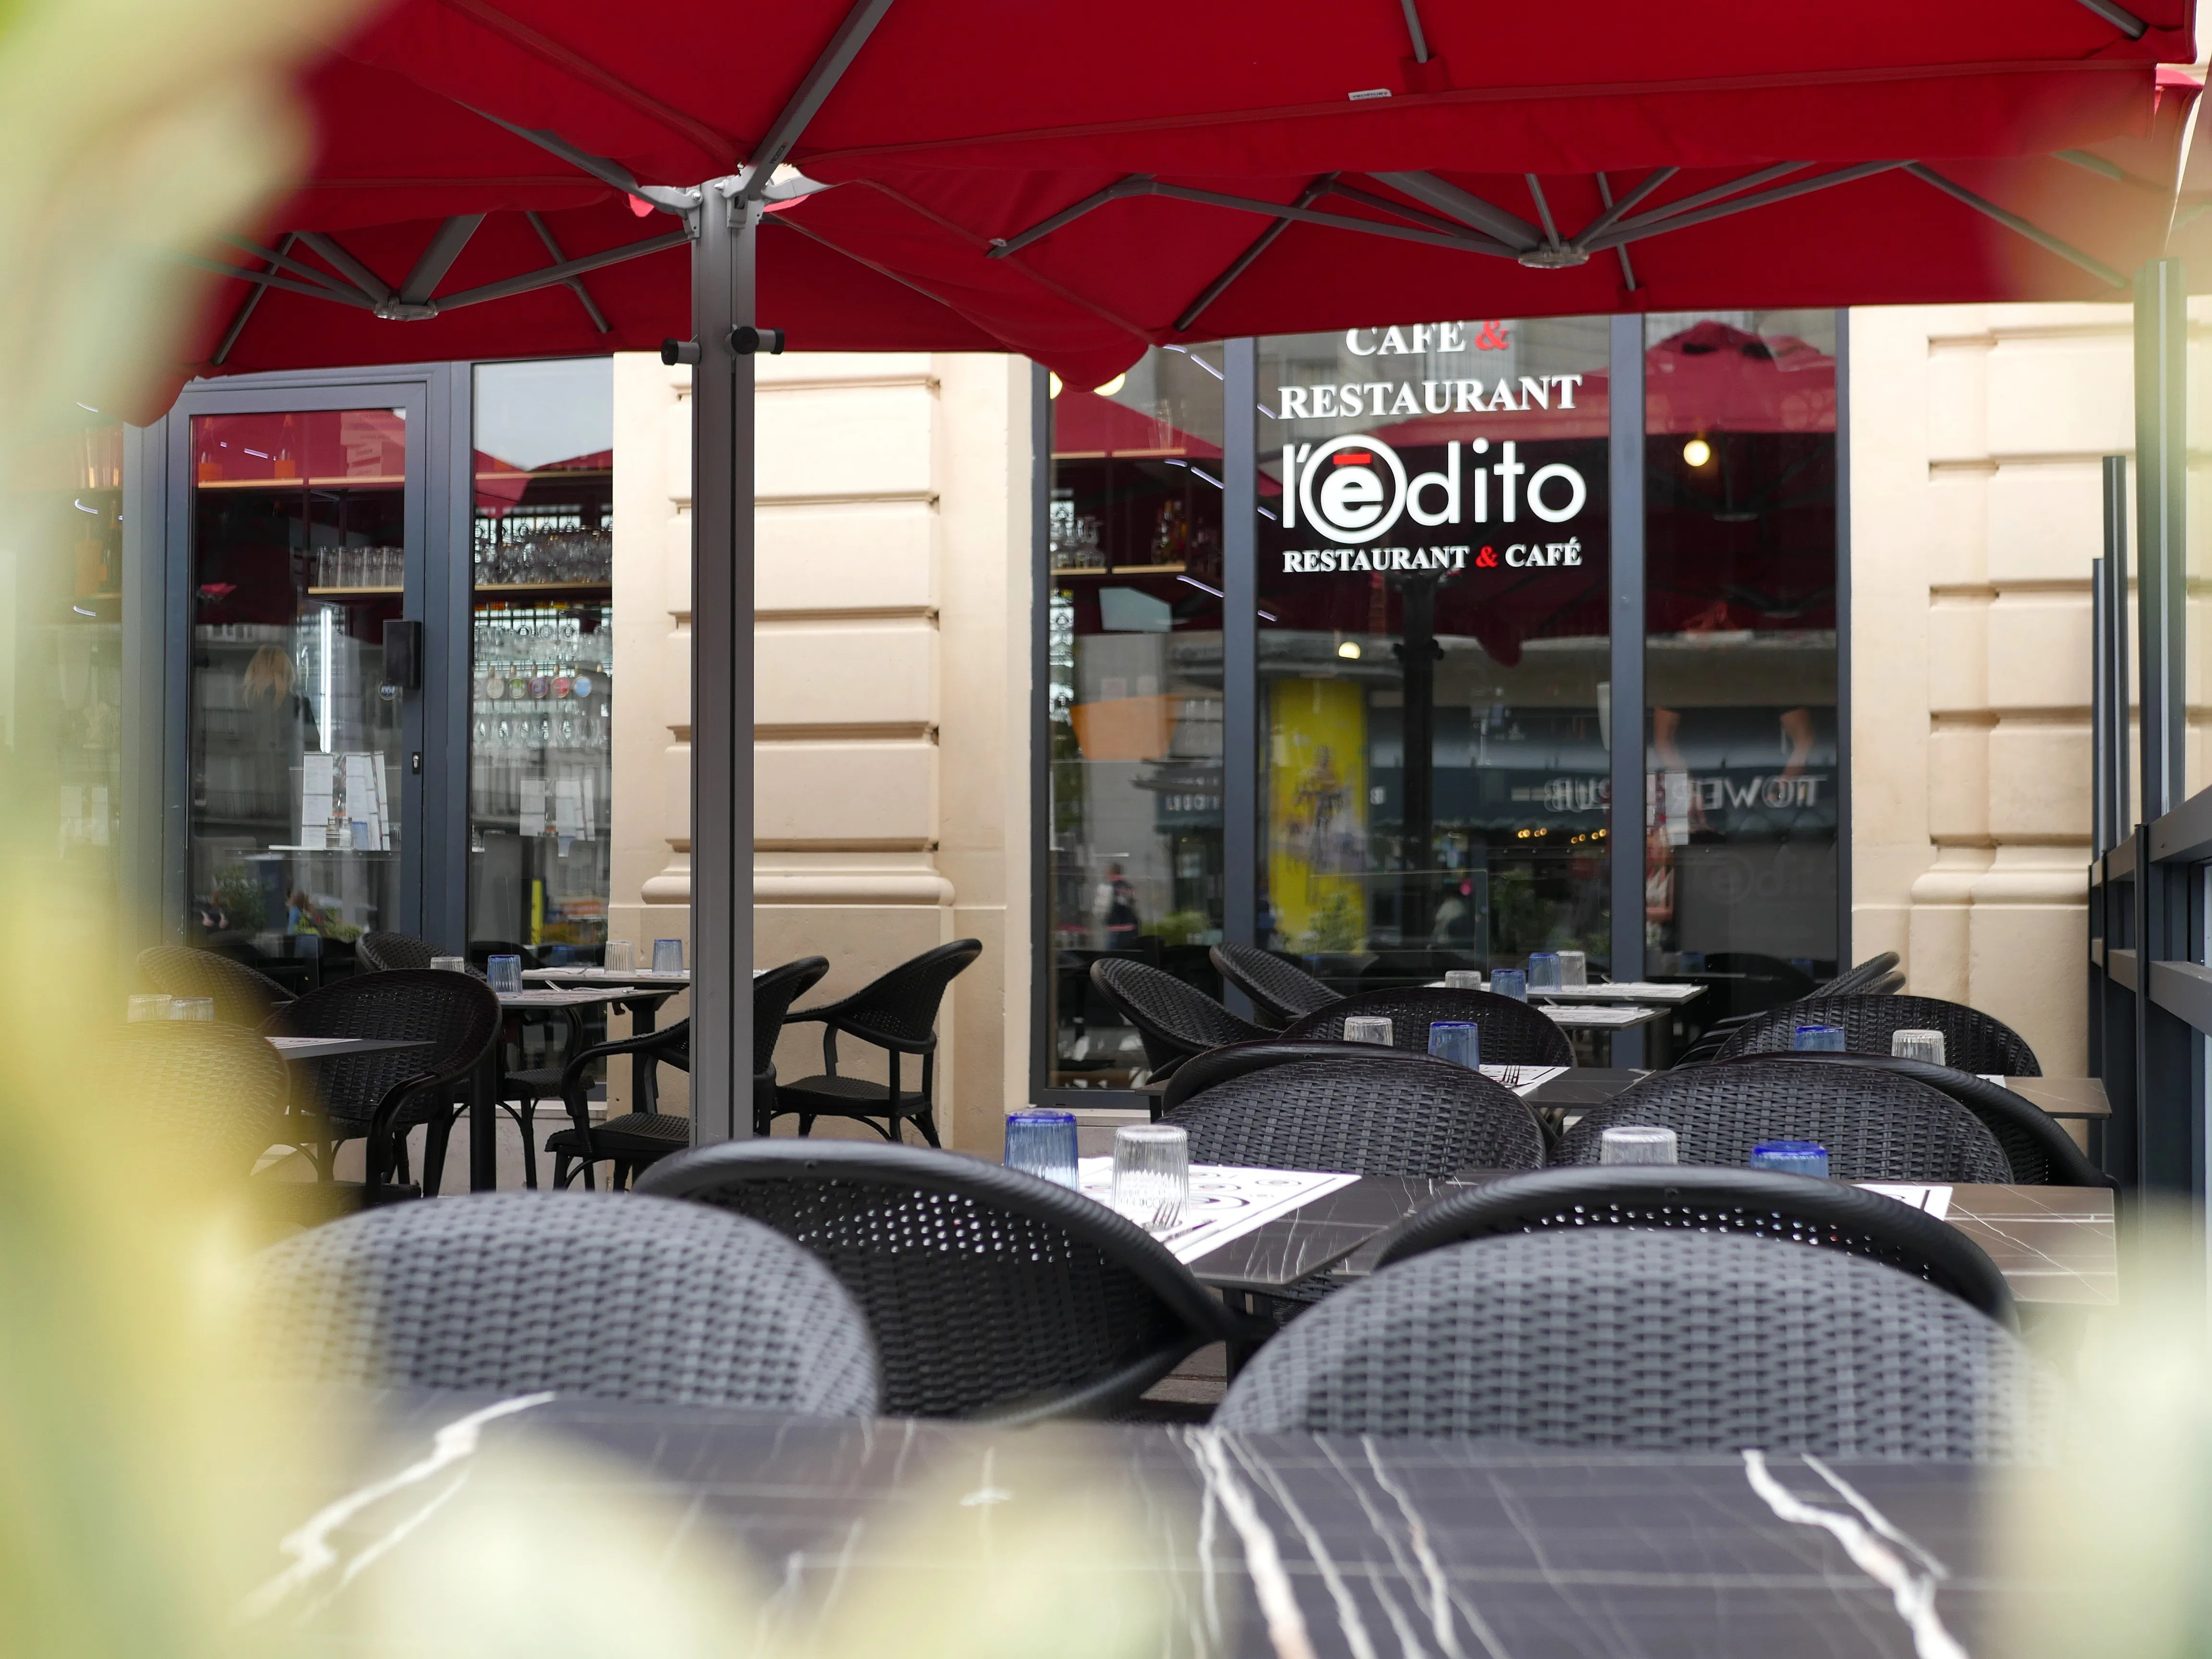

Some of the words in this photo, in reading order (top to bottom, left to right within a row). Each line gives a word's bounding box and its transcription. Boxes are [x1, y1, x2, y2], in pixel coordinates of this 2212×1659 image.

[1475, 319, 1509, 350] &
[1277, 374, 1583, 419] RESTAURANT
[1282, 545, 1470, 573] RESTAURANT
[1476, 545, 1498, 568] &
[1505, 536, 1583, 567] CAFÉ
